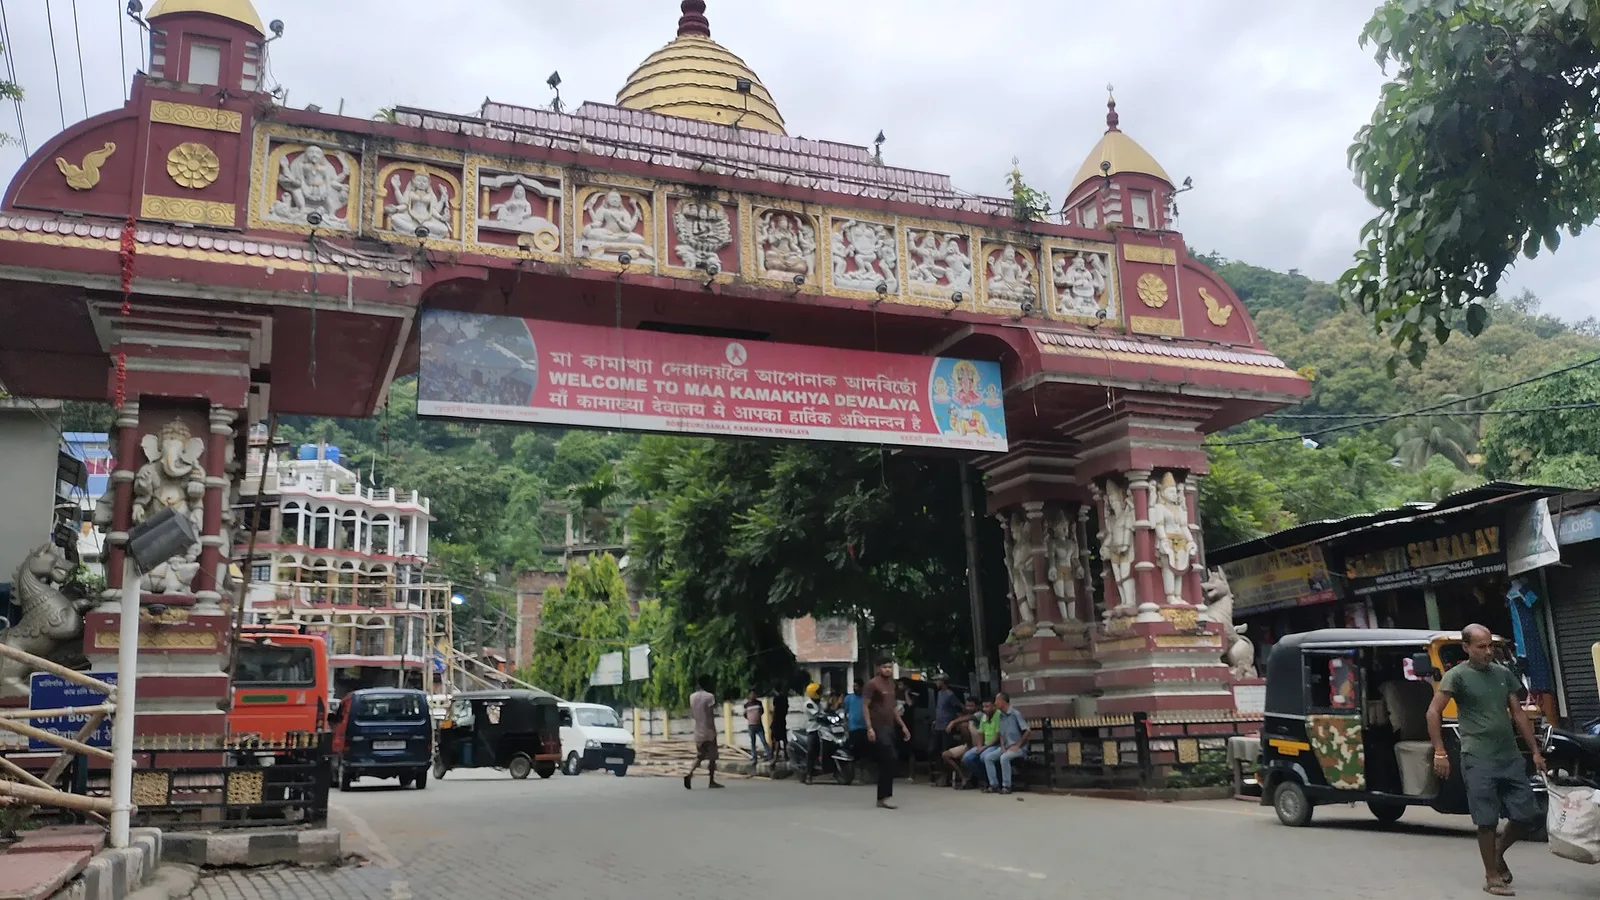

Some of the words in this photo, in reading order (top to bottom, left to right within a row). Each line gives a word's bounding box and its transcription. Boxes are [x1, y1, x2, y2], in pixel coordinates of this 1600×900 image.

[549, 351, 573, 367] মা
[549, 371, 648, 392] WELCOME
[653, 380, 679, 395] TO
[685, 383, 725, 398] MAA
[730, 386, 831, 406] KAMAKHYA
[834, 394, 921, 412] DEVALAYA
[577, 394, 645, 412] कामाख्या
[652, 396, 706, 416] देवालय
[732, 406, 782, 422] आपका
[789, 406, 832, 426] हार्दिक
[839, 410, 906, 430] अभिनन्दन
[775, 427, 810, 435] DEVALAYA
